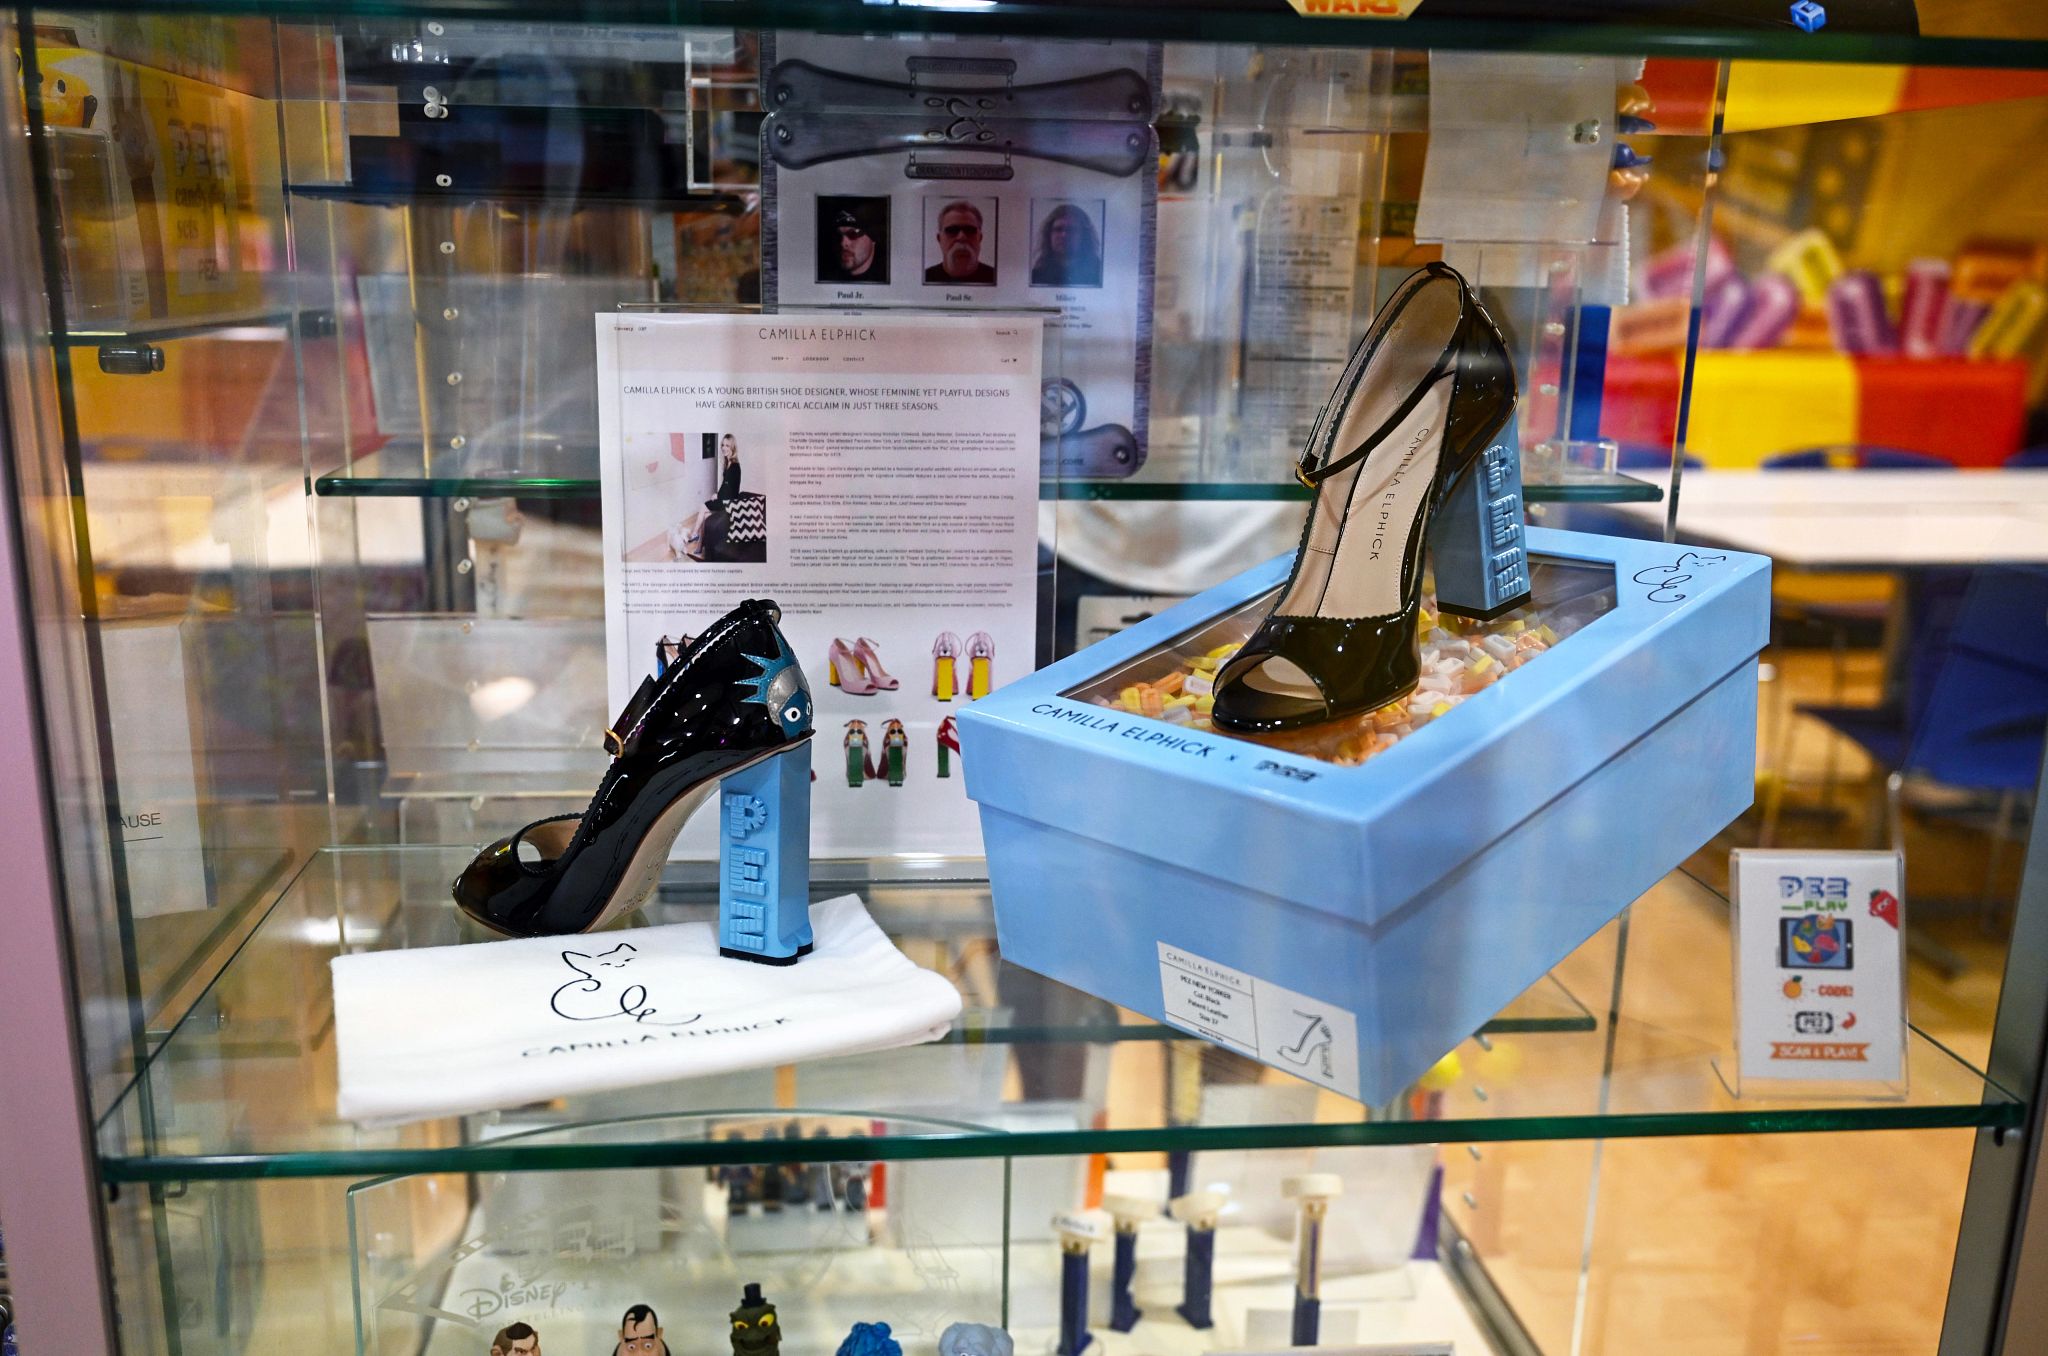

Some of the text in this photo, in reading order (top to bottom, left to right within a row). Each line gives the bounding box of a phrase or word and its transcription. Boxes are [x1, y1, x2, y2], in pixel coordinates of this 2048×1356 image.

[759, 328, 877, 341] CAMILLA ELPHICK
[623, 386, 1010, 398] CAMILLA ELPHICK IS A YOUNG BRITISH SHOE DESIGNER, WHOSE FEMININE YET PLAYFUL DESIGNS
[695, 401, 938, 411] HAVE GARNERED CRITICAL ACCLAIM IN JUST THREE SEASONS.
[1369, 428, 1430, 561] CAMILLA ELPHICK
[1483, 444, 1524, 600] PEZ
[1032, 703, 1119, 733] CAMILLA
[1121, 726, 1218, 759] ELPHICK
[724, 792, 768, 950] PEZ
[1779, 876, 1849, 899] PEZ
[1804, 901, 1848, 912] PLAY
[1166, 952, 1241, 986] CAMILLA ELPHICK
